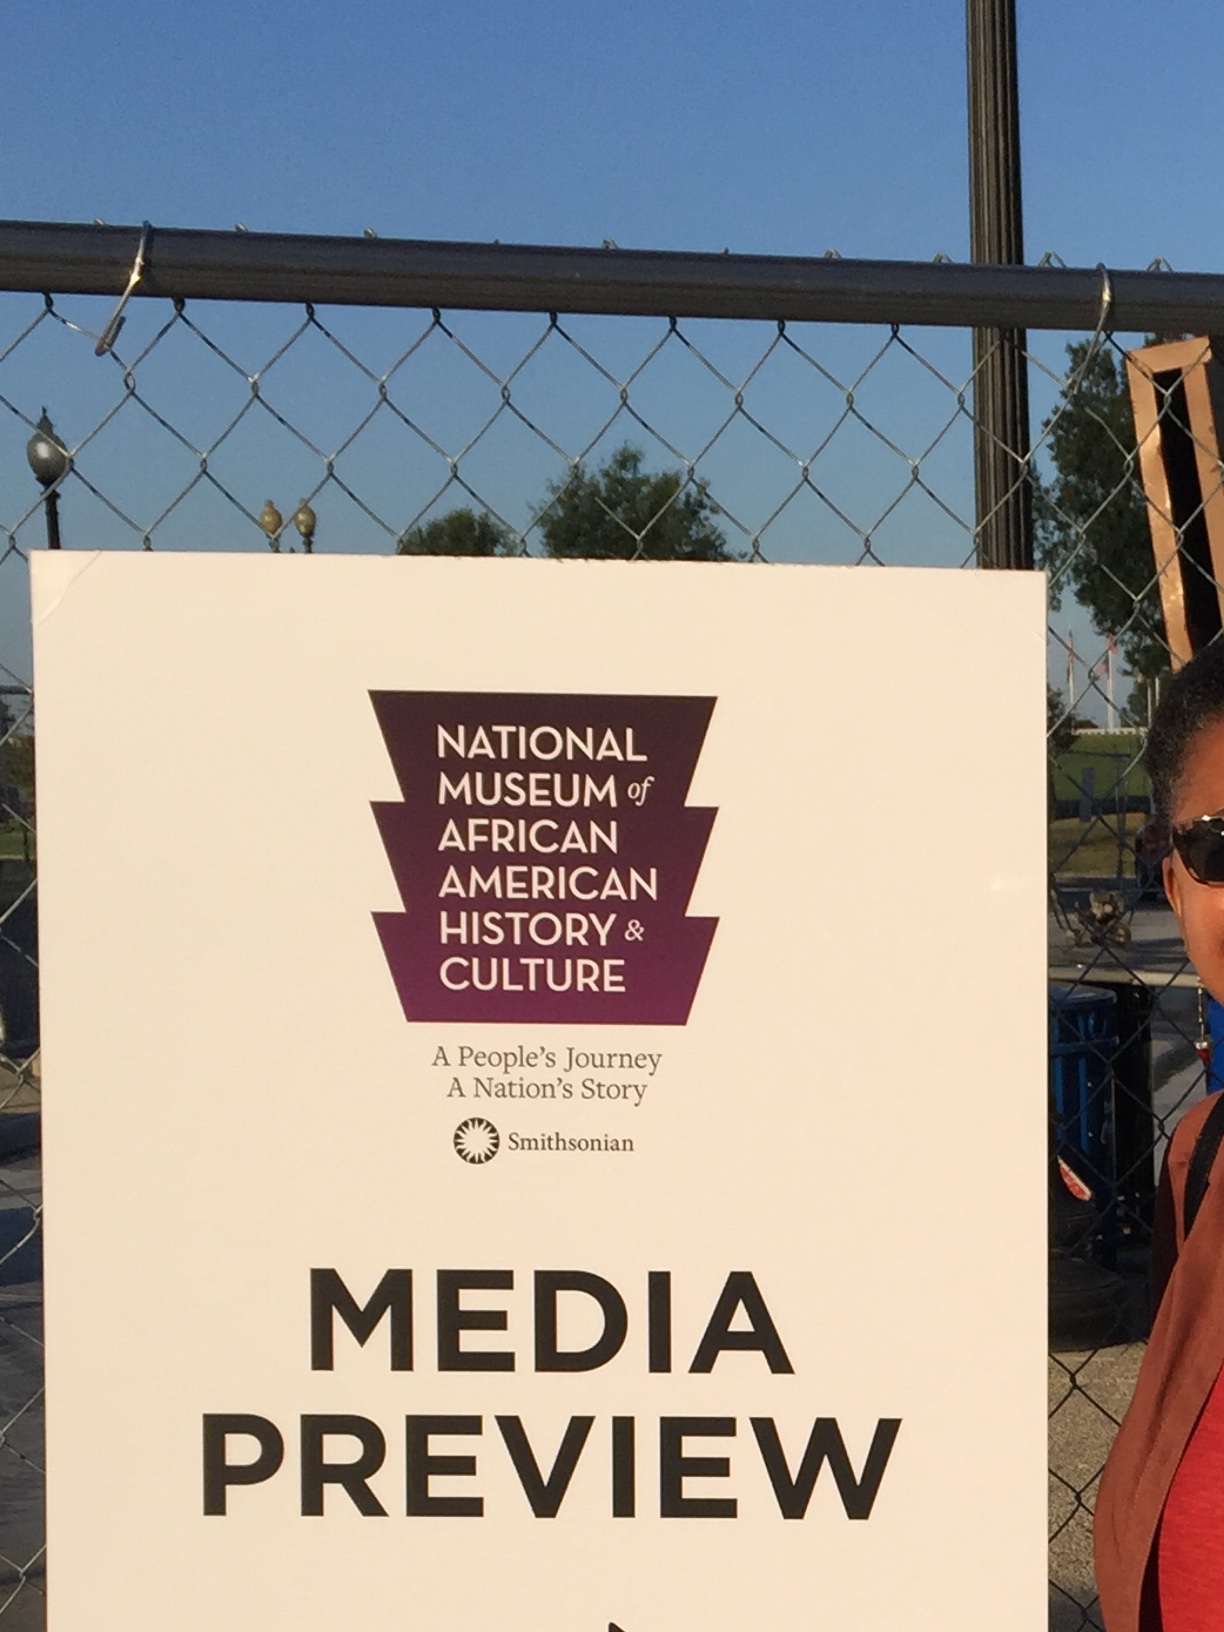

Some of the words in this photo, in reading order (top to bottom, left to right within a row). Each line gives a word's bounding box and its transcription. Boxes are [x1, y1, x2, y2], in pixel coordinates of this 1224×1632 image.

[437, 724, 648, 762] NATIONAL
[438, 771, 618, 808] MUSEUM
[627, 775, 655, 807] of
[437, 818, 618, 854] AFRICAN
[438, 865, 658, 901] AMERICAN
[440, 911, 617, 946] HISTORY
[624, 919, 645, 942] &
[439, 956, 626, 993] CULTURE
[432, 1045, 451, 1067] A
[458, 1045, 557, 1075] People’s
[563, 1046, 663, 1077] Journey
[446, 1076, 467, 1099] A
[473, 1076, 574, 1100] Nation’s
[581, 1077, 648, 1107] Story
[508, 1131, 635, 1153] Smithsonian
[310, 1267, 796, 1375] MEDIA
[202, 1413, 903, 1521] PREVIEW
